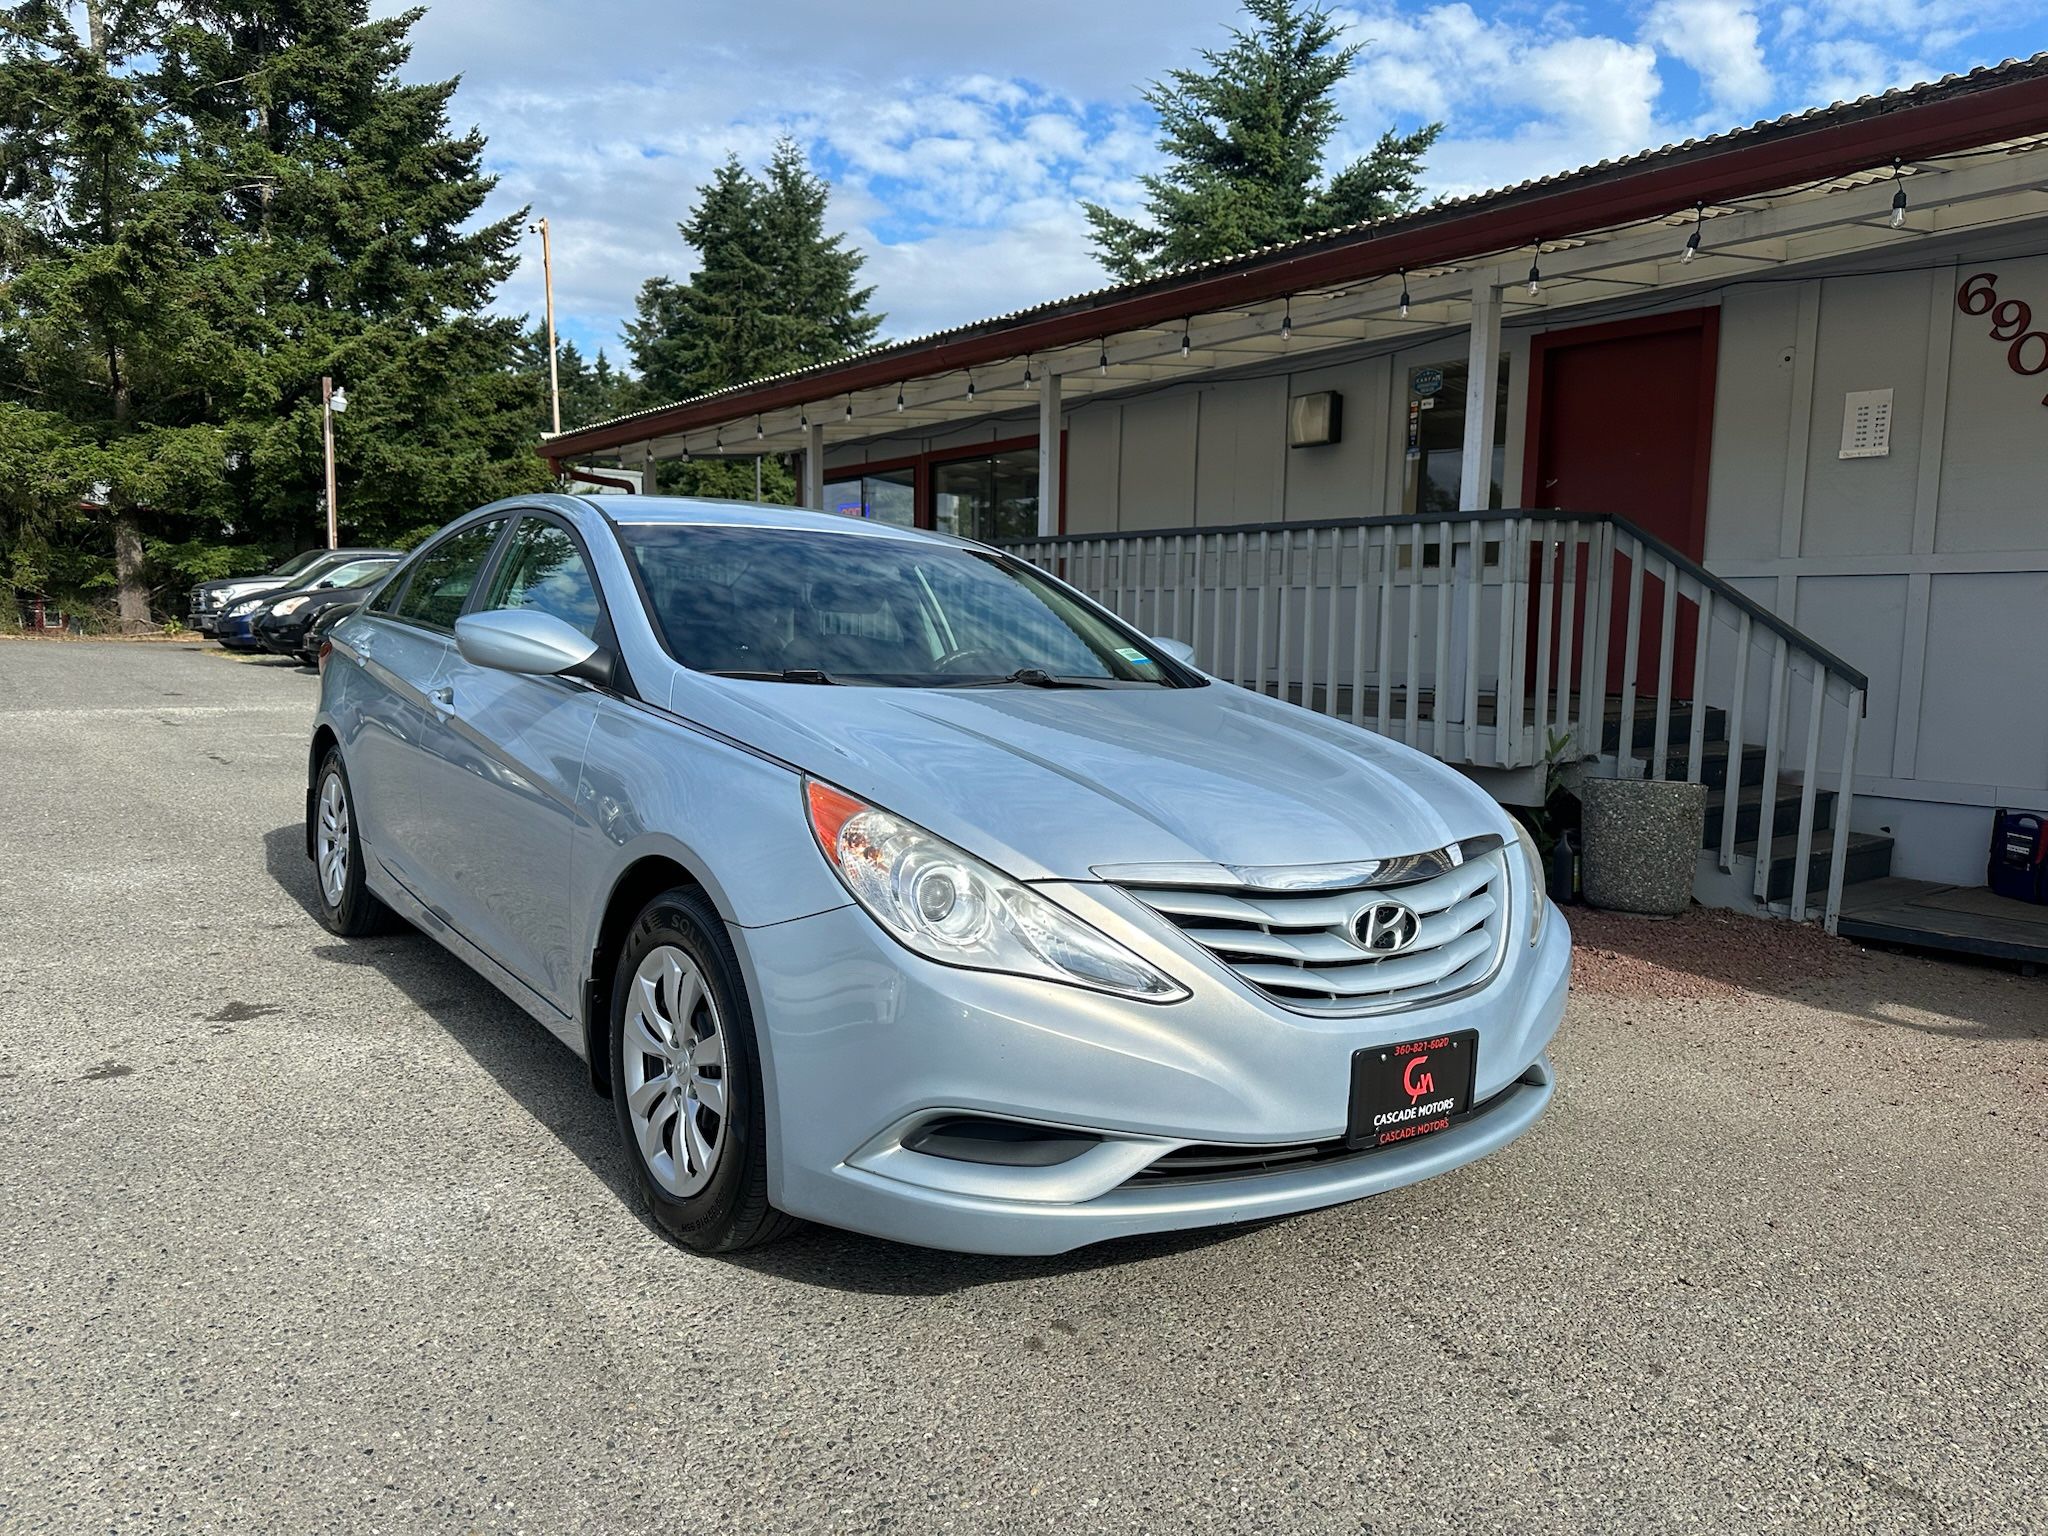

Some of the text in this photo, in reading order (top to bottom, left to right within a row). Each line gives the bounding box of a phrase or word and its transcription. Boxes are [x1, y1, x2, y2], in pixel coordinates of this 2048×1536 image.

[1958, 273, 2048, 407] 690
[1394, 1037, 1449, 1056] 360-821-6020
[1373, 1097, 1455, 1127] CASCADE MOTORS
[1380, 1119, 1450, 1144] CASCADE MOTORS
